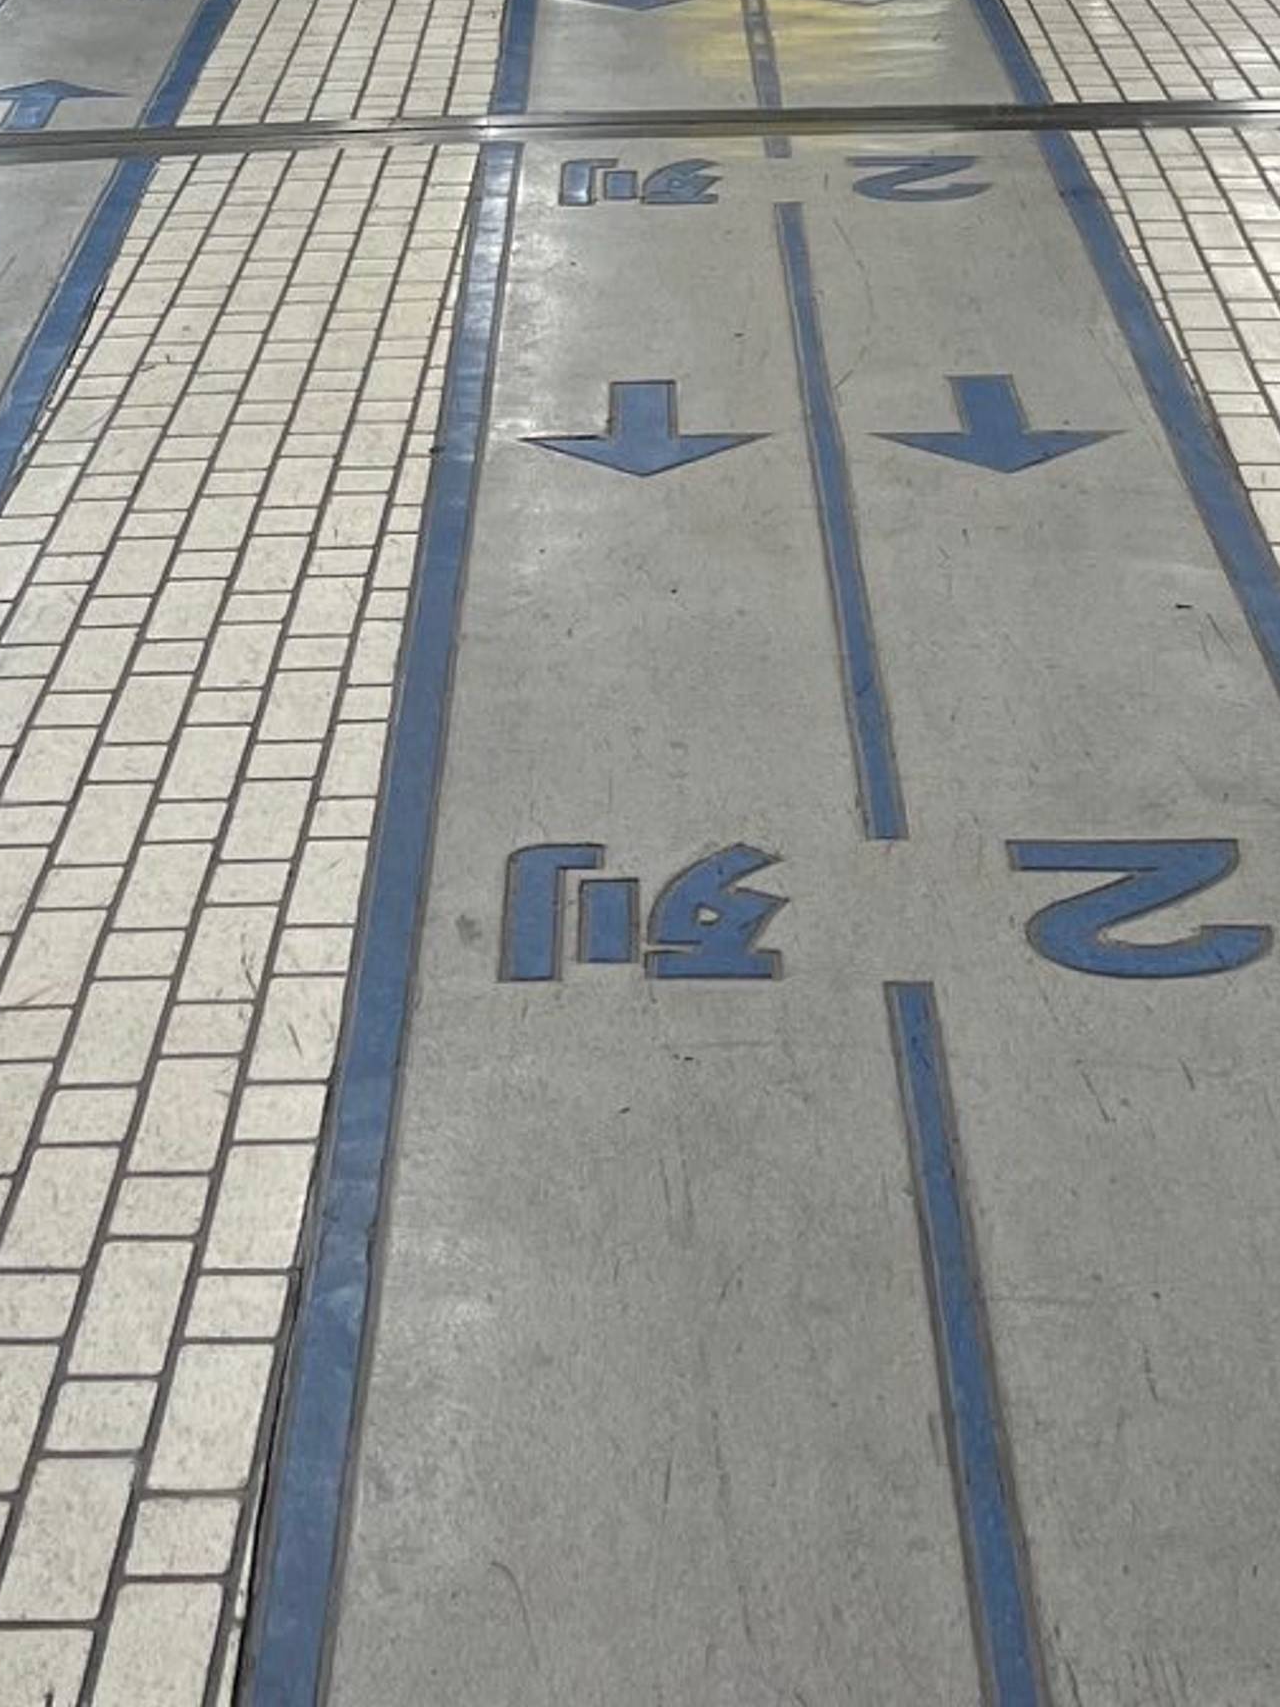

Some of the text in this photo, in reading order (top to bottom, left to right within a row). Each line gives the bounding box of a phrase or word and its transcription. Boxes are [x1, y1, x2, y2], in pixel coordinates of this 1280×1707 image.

[558, 155, 994, 205] 2 列
[498, 837, 1275, 981] 2 列
